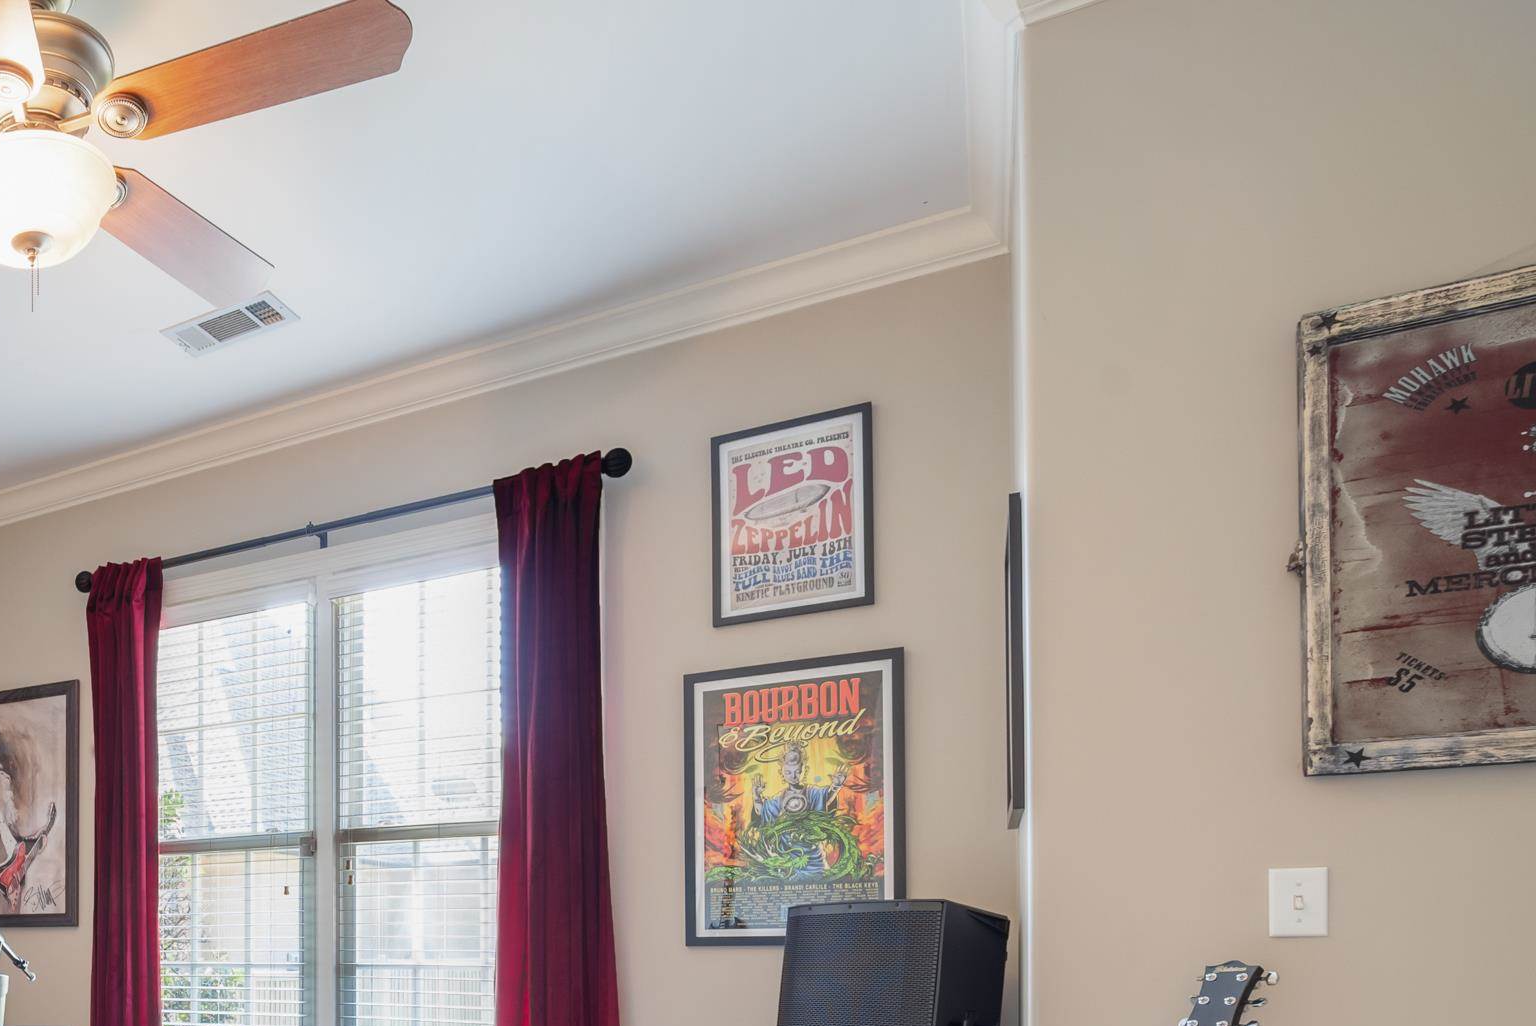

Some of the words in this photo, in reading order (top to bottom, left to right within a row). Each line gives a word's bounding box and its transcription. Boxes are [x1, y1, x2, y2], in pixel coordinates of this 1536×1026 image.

[1382, 342, 1477, 404] MOHAWK
[731, 455, 743, 464] THE
[744, 447, 773, 461] ELECTRIC
[774, 441, 803, 453] THEATRE
[817, 431, 850, 444] PRESENTS
[732, 446, 850, 517] LED
[731, 478, 853, 556] ZEPPELIN
[732, 552, 783, 567] FRIDAY,
[787, 544, 817, 563] JULY
[821, 535, 853, 557] 18TH
[819, 550, 853, 569] THE
[732, 564, 771, 580] JETHRO
[732, 572, 771, 592] TULL
[772, 573, 795, 583] BLUES
[796, 566, 817, 580] BAND
[819, 561, 852, 577] LITTER
[736, 587, 771, 603] KINETIC
[773, 576, 835, 597] PLAYGROUND
[1387, 667, 1425, 693] $5
[1396, 651, 1446, 681] TICKETS
[723, 677, 862, 728] BOURBON
[718, 726, 740, 750] &
[735, 708, 866, 762] Beyond
